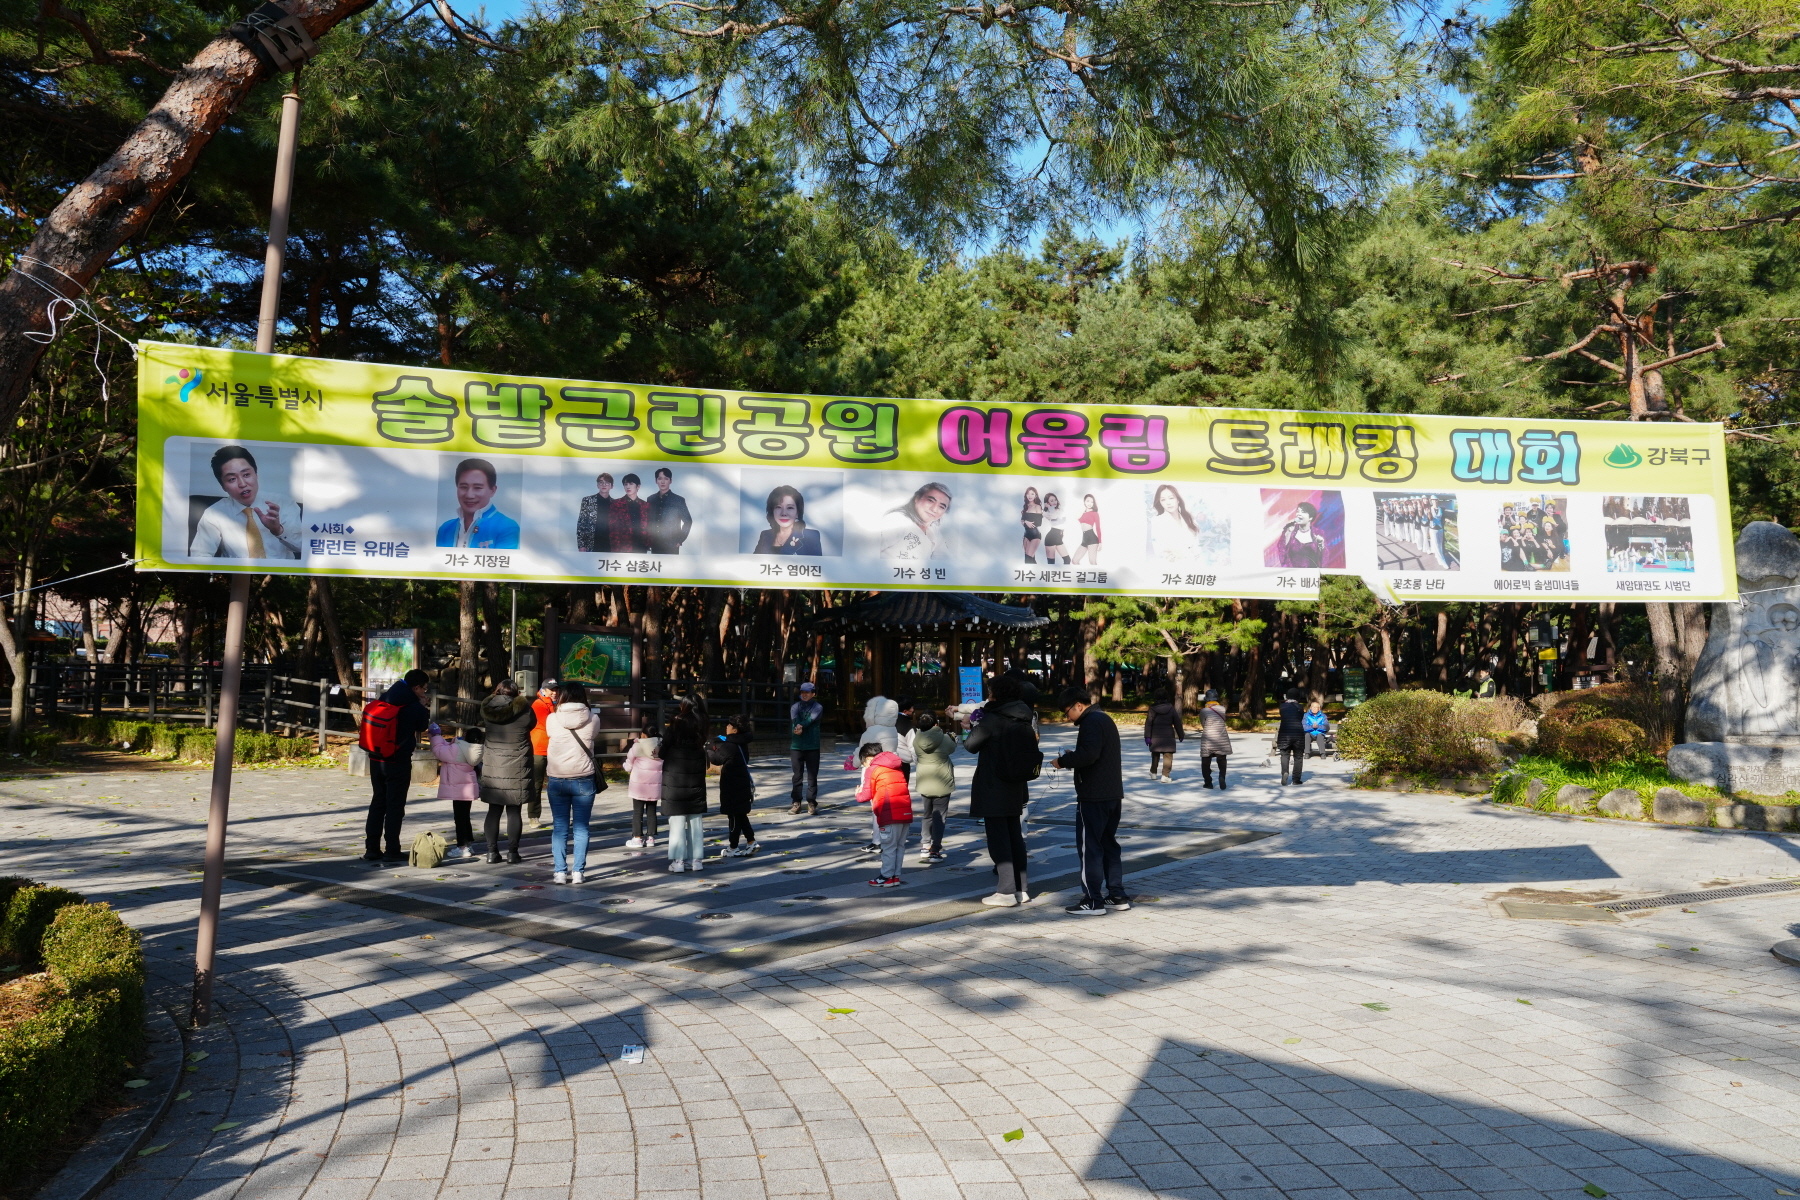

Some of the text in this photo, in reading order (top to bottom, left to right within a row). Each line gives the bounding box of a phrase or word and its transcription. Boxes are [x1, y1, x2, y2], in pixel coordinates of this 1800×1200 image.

[206, 382, 323, 411] 서울특별시
[371, 375, 1581, 486] 솔밭근린공원 어울림 트래킹 대회
[1647, 446, 1711, 467] 강북구
[321, 523, 344, 535] 사회
[310, 539, 410, 558] 탤런트 유태슬
[445, 553, 511, 568] 가수 지장원
[597, 559, 662, 573] 가수 삼총사
[760, 563, 822, 577] 가수 염어진
[893, 566, 947, 580] 가수 성 빈
[1014, 570, 1108, 584] 가수 세컨드 걸그룹
[1161, 573, 1217, 586] 가수 최미향
[1276, 576, 1297, 588] 가수
[1393, 578, 1445, 590] 꽃초롱 난타
[1493, 579, 1580, 591] 에어로빅 솔샘미녀들
[1616, 580, 1692, 591] 새암태권도 시범단
